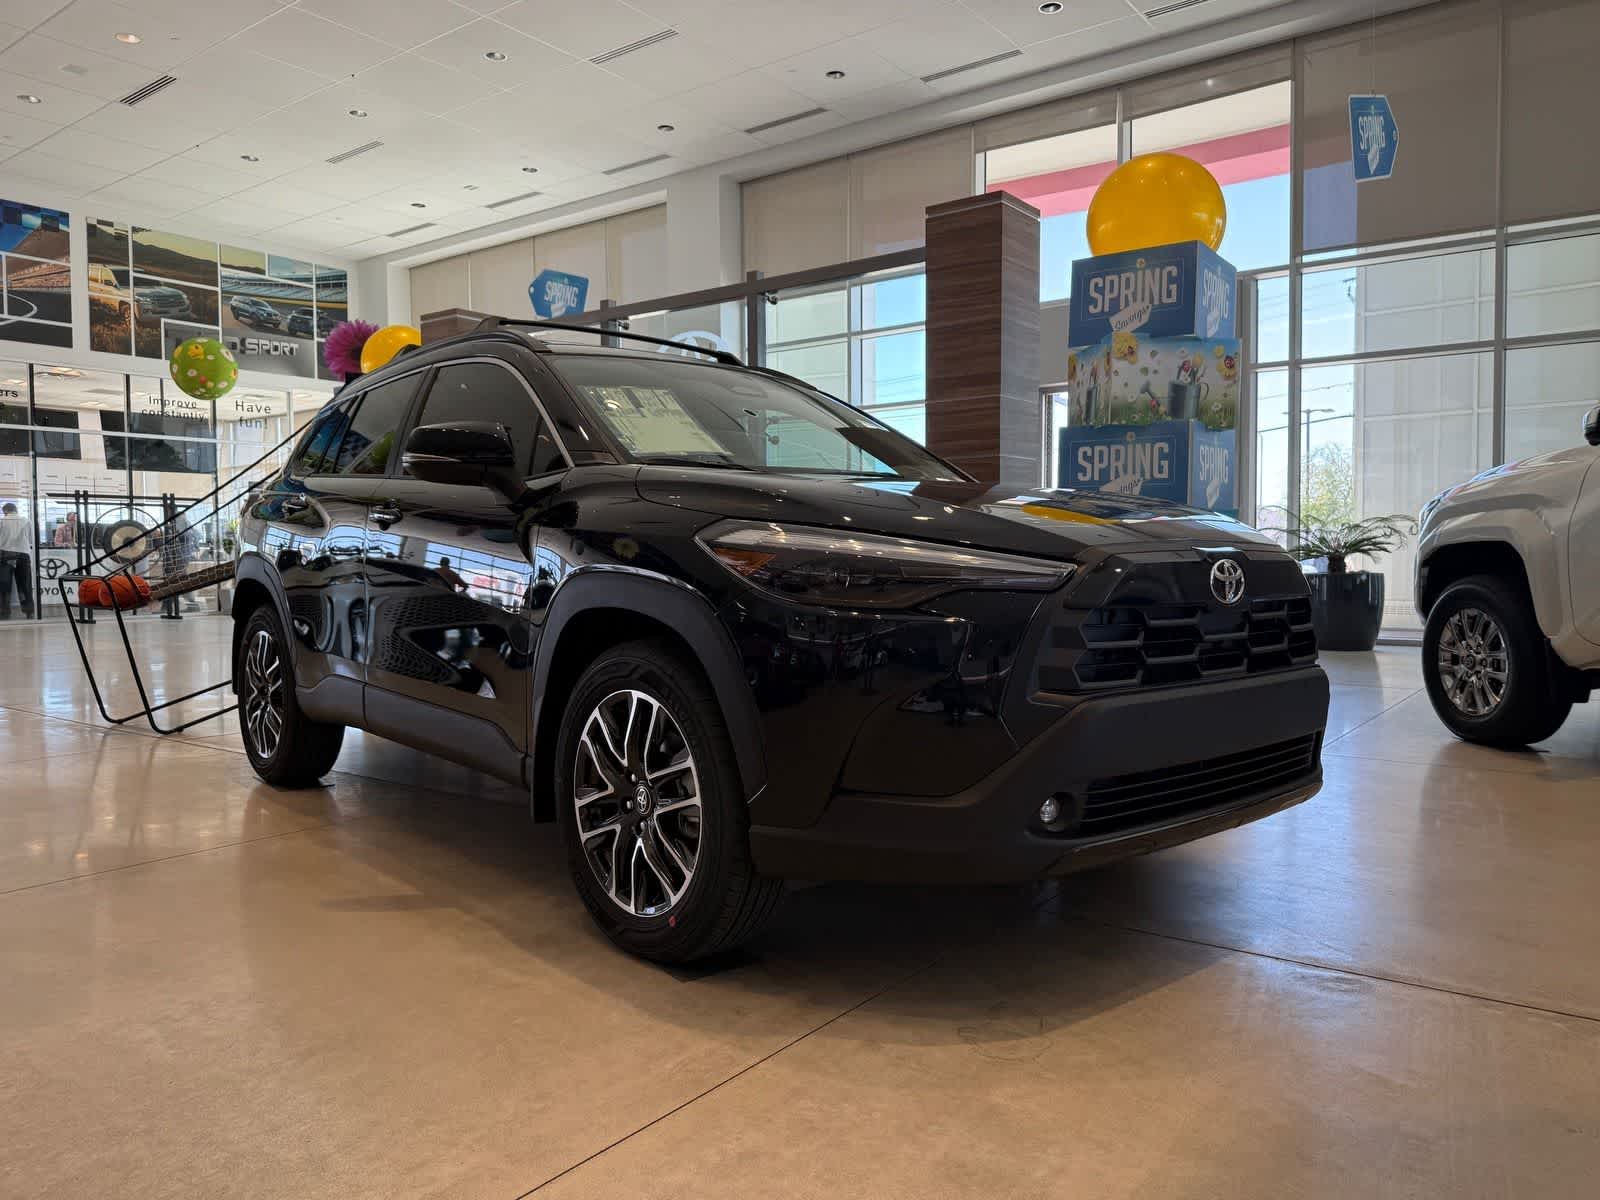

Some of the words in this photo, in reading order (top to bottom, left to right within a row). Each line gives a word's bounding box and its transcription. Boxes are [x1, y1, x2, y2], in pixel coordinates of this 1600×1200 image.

[1359, 115, 1386, 150] SPRING
[544, 281, 579, 308] SPRING
[1088, 265, 1178, 314] SPRING
[1203, 269, 1230, 319] SPRING
[246, 338, 300, 356] SPORT
[149, 396, 197, 408] Improve
[235, 399, 272, 414] Have
[239, 416, 268, 429] fun!
[1077, 441, 1169, 481] SPRING
[1200, 445, 1229, 484] SPRING
